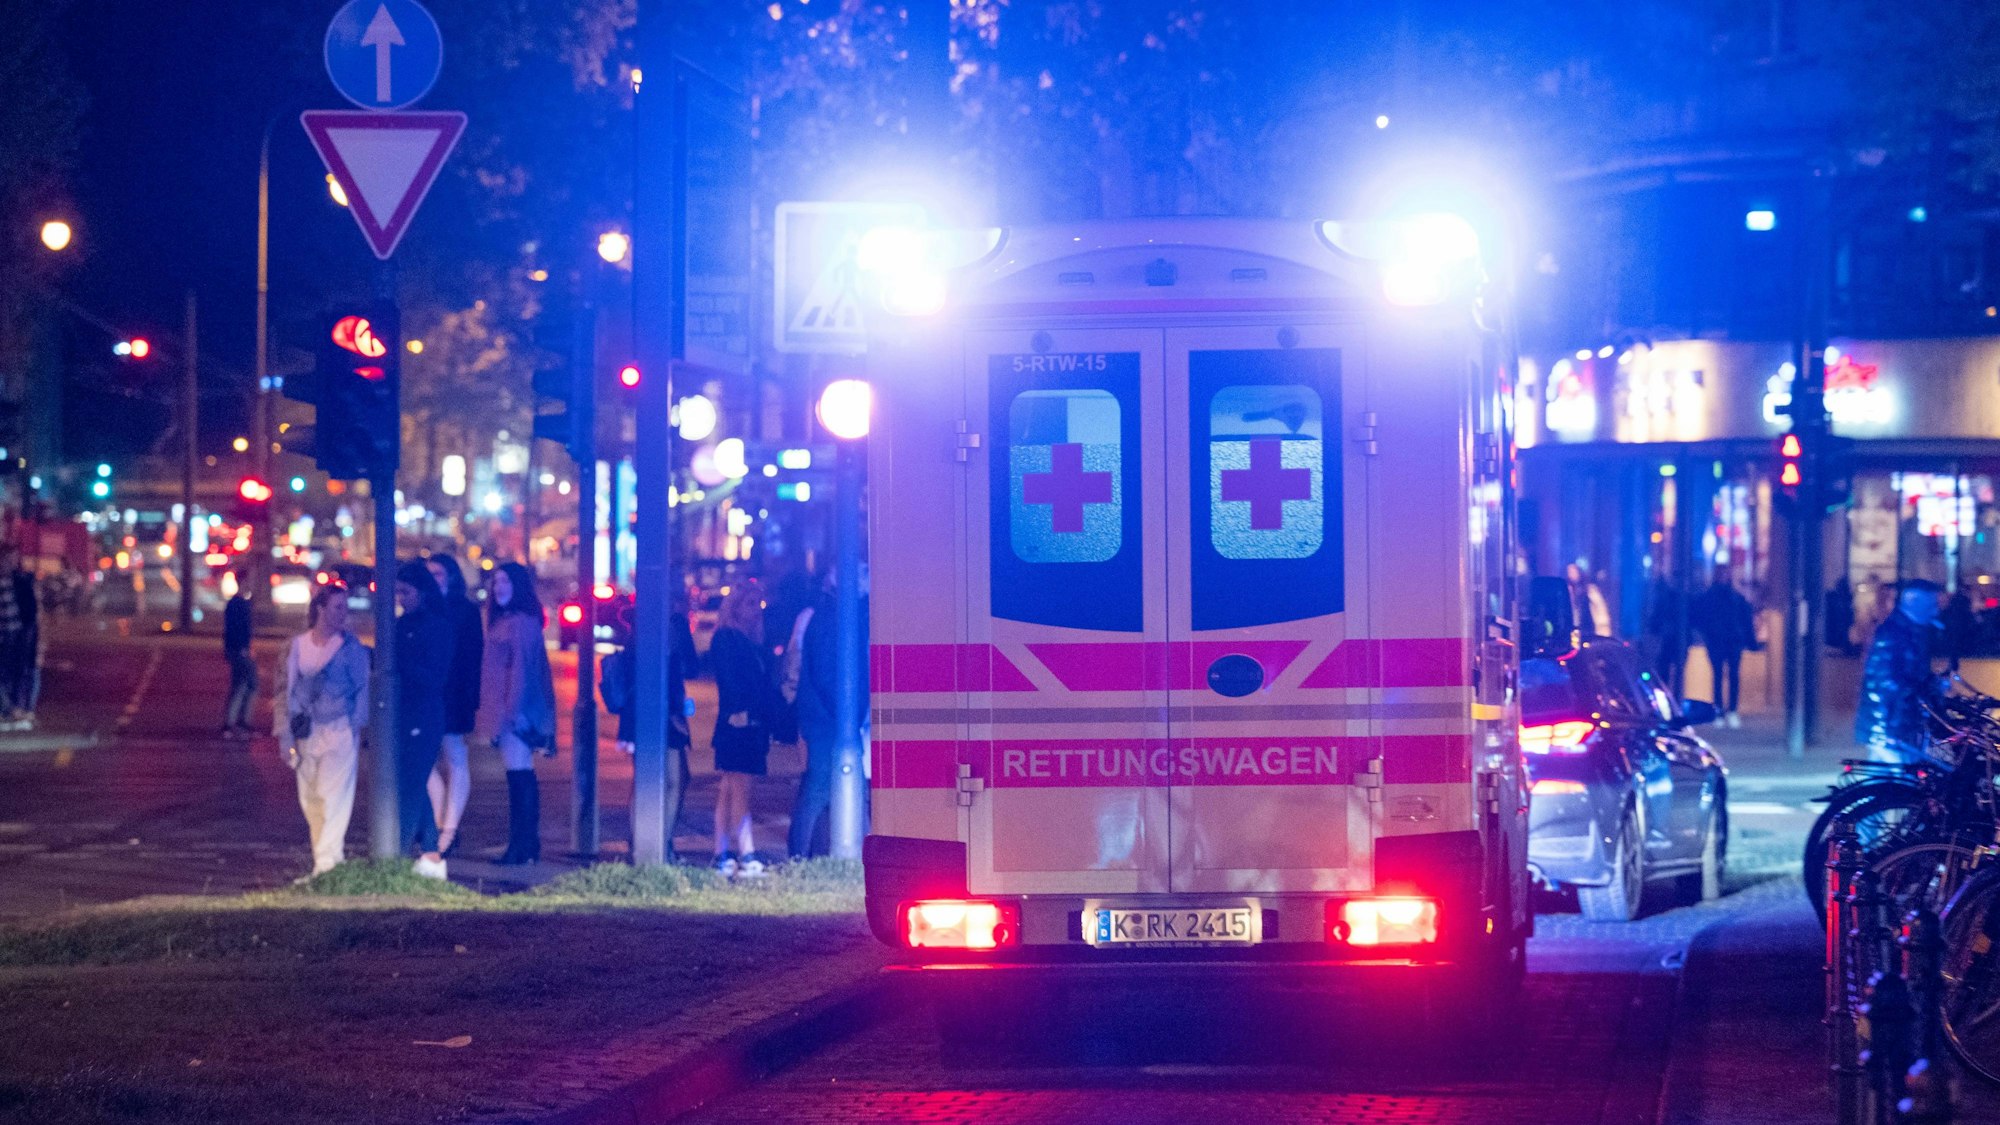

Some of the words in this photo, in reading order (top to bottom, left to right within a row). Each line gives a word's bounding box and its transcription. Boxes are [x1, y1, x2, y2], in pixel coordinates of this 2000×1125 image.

[1013, 355, 1107, 372] 5-RTW-15
[1003, 747, 1338, 777] RETTUNGSWAGEN
[1147, 914, 1178, 938] RK
[1186, 913, 1246, 937] 2415
